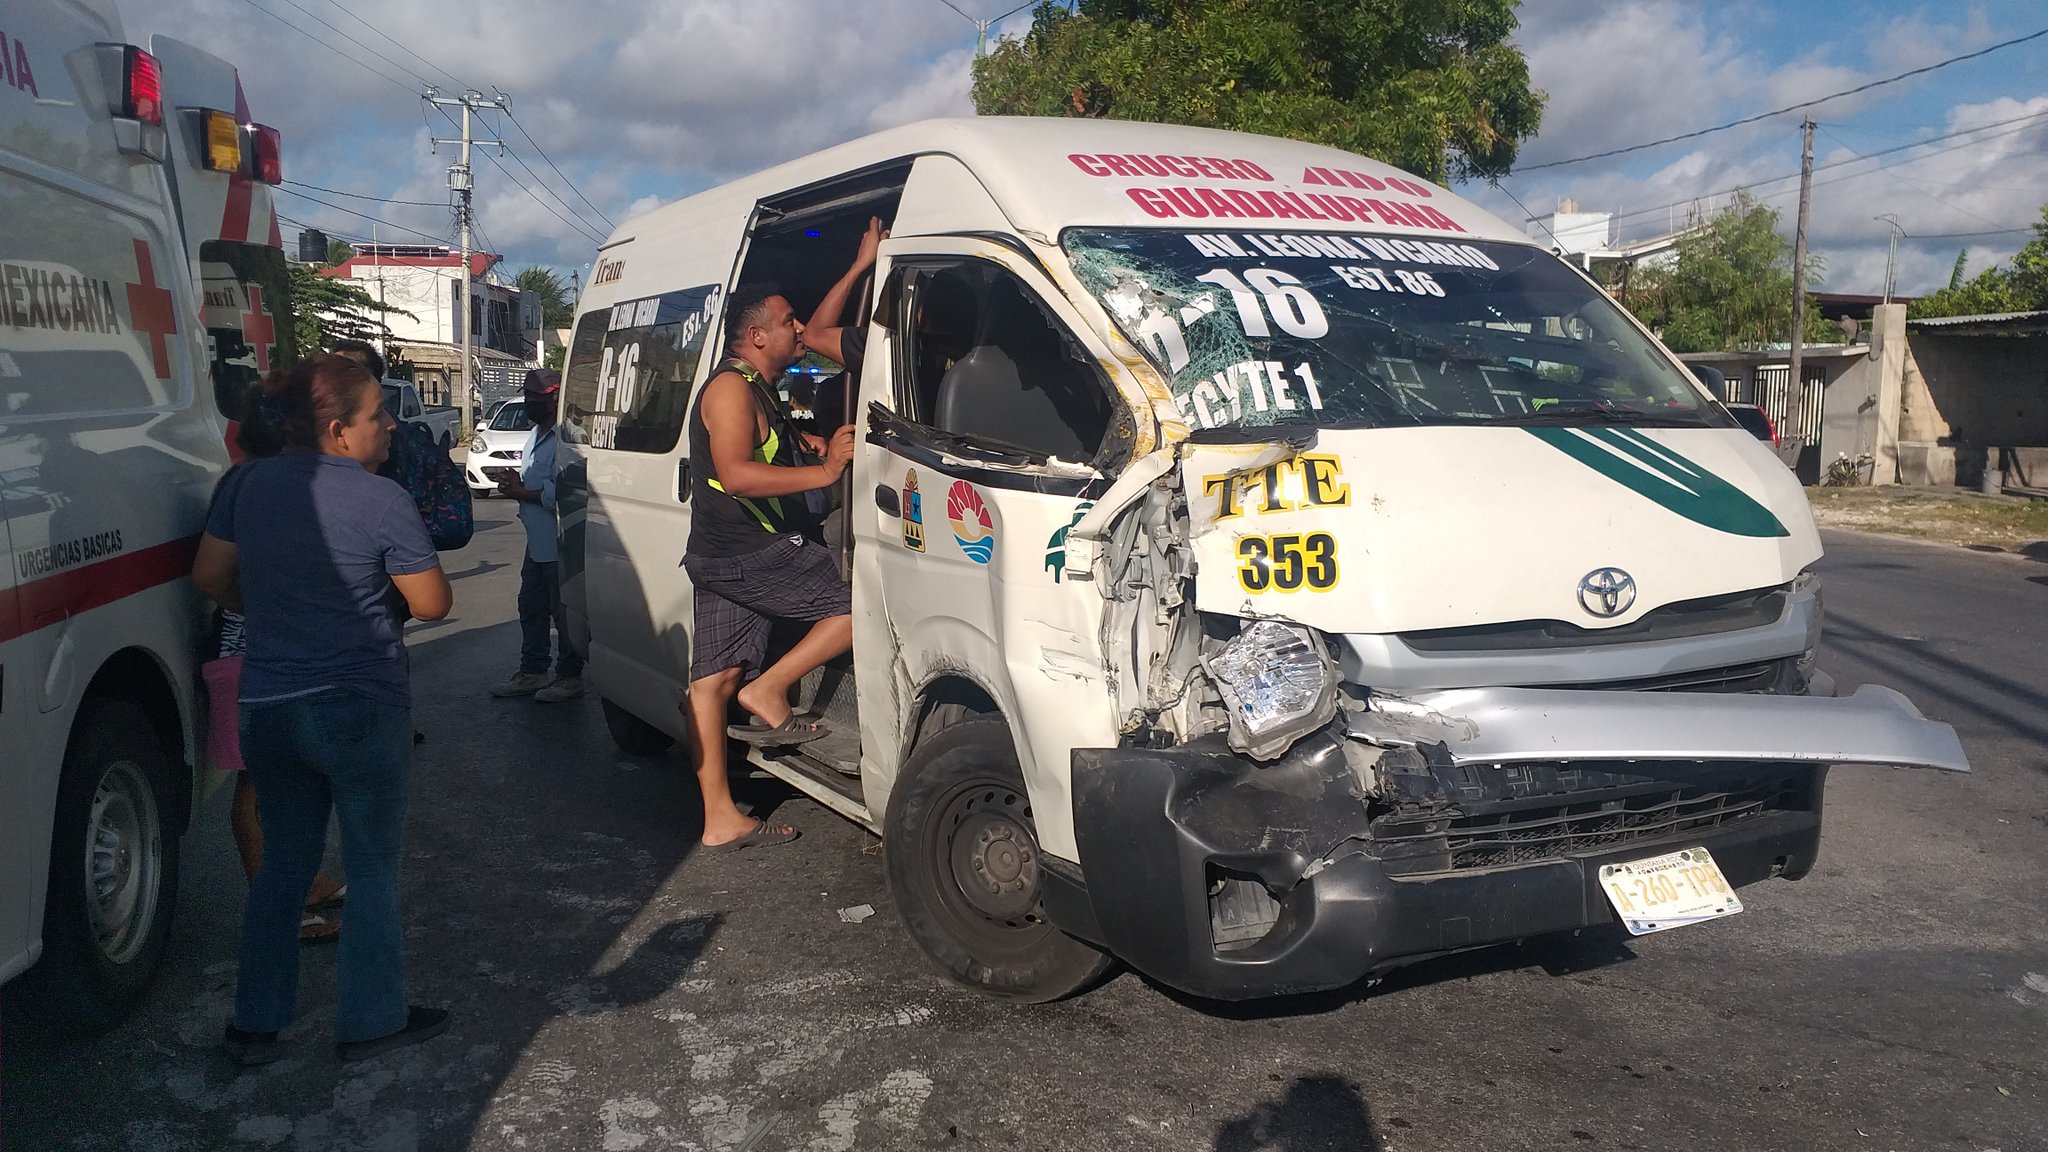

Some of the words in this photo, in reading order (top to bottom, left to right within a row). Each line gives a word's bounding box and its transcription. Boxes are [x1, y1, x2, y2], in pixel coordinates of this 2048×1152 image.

[1066, 153, 1275, 182] CRUCERO
[1125, 188, 1469, 233] GUADALUPANA
[1184, 234, 1259, 258] AV.
[1242, 234, 1372, 260] LEONA
[1350, 237, 1500, 271] VICARIO
[703, 285, 720, 324] 86
[1395, 270, 1446, 298] 86
[595, 342, 640, 414] R-16
[18, 539, 82, 578] URGENCIAS
[82, 529, 123, 560] BASICAS
[1237, 532, 1339, 593] 353
